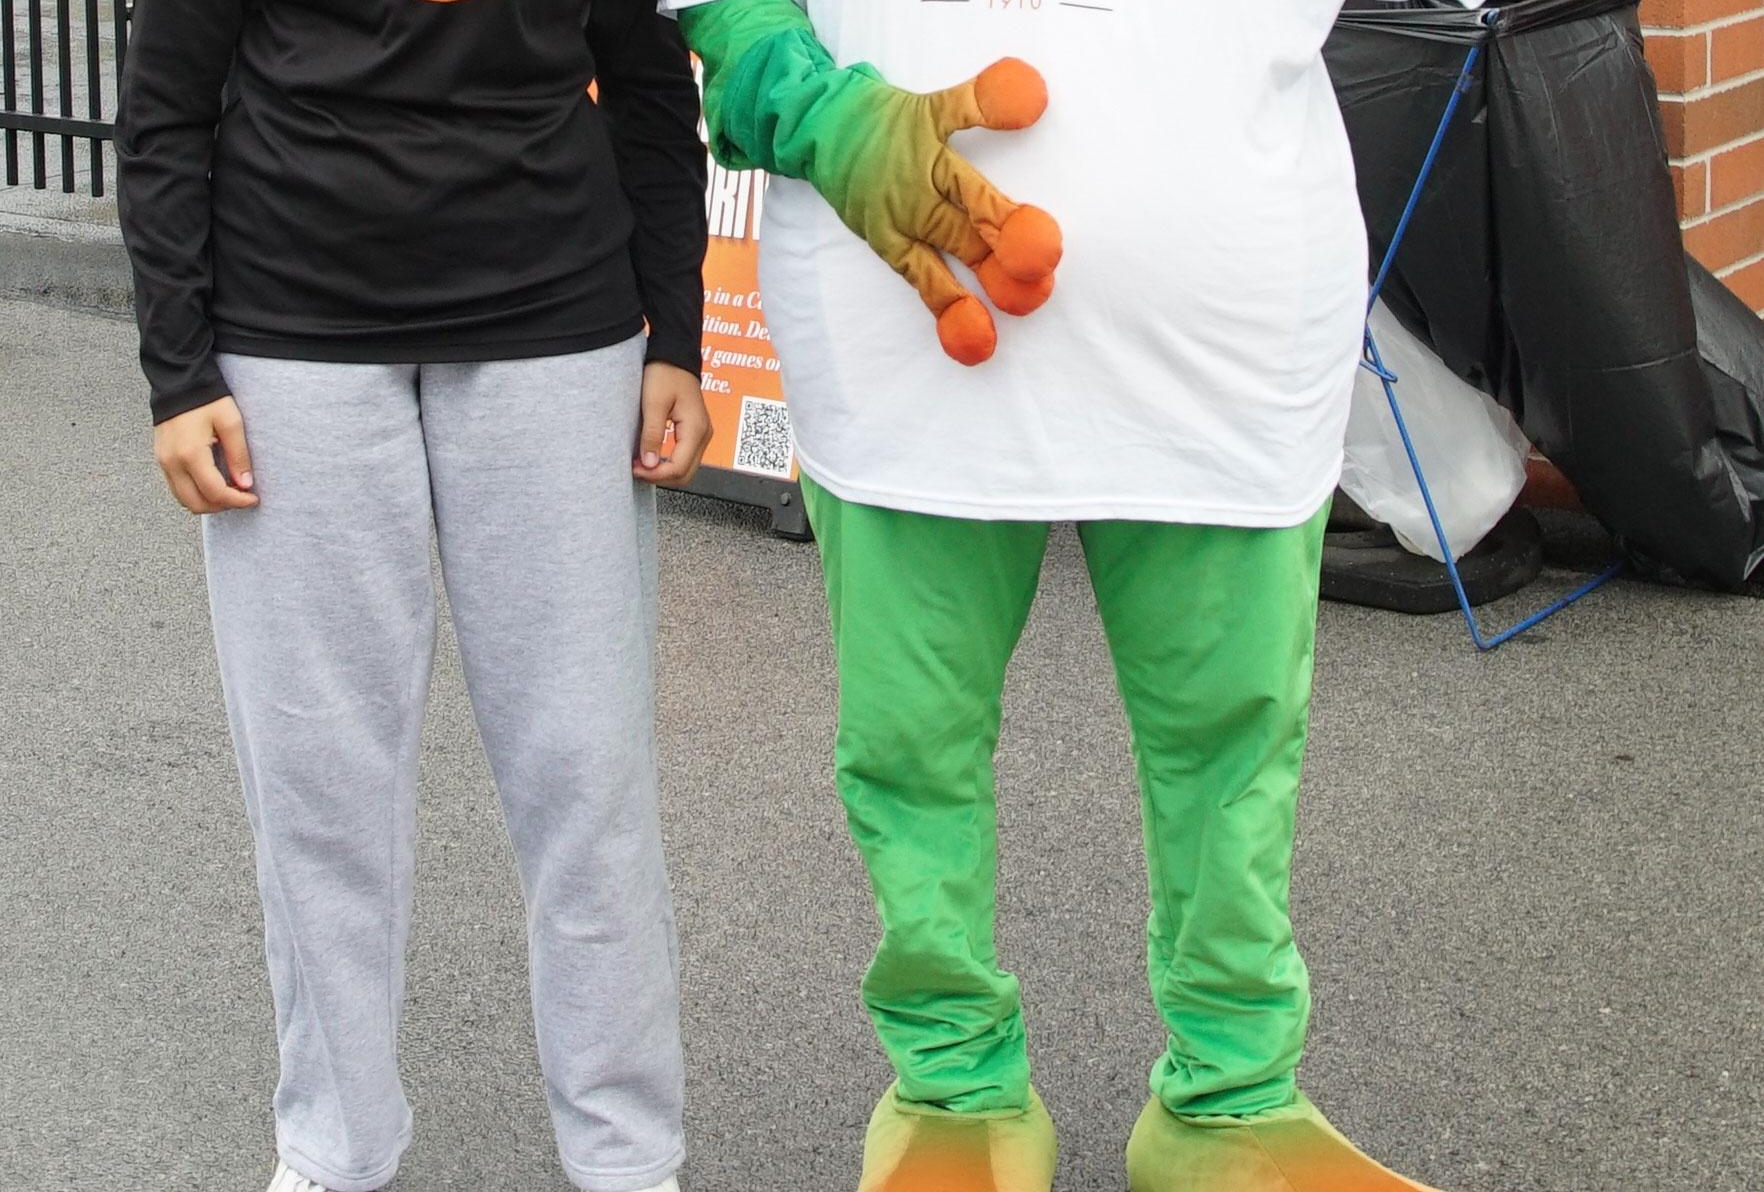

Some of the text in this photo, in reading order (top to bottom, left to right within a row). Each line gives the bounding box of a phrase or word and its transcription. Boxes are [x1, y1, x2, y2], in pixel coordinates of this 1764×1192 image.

[713, 287, 731, 305] in
[732, 293, 744, 308] a
[702, 314, 742, 337] ition.
[711, 350, 764, 369] games
